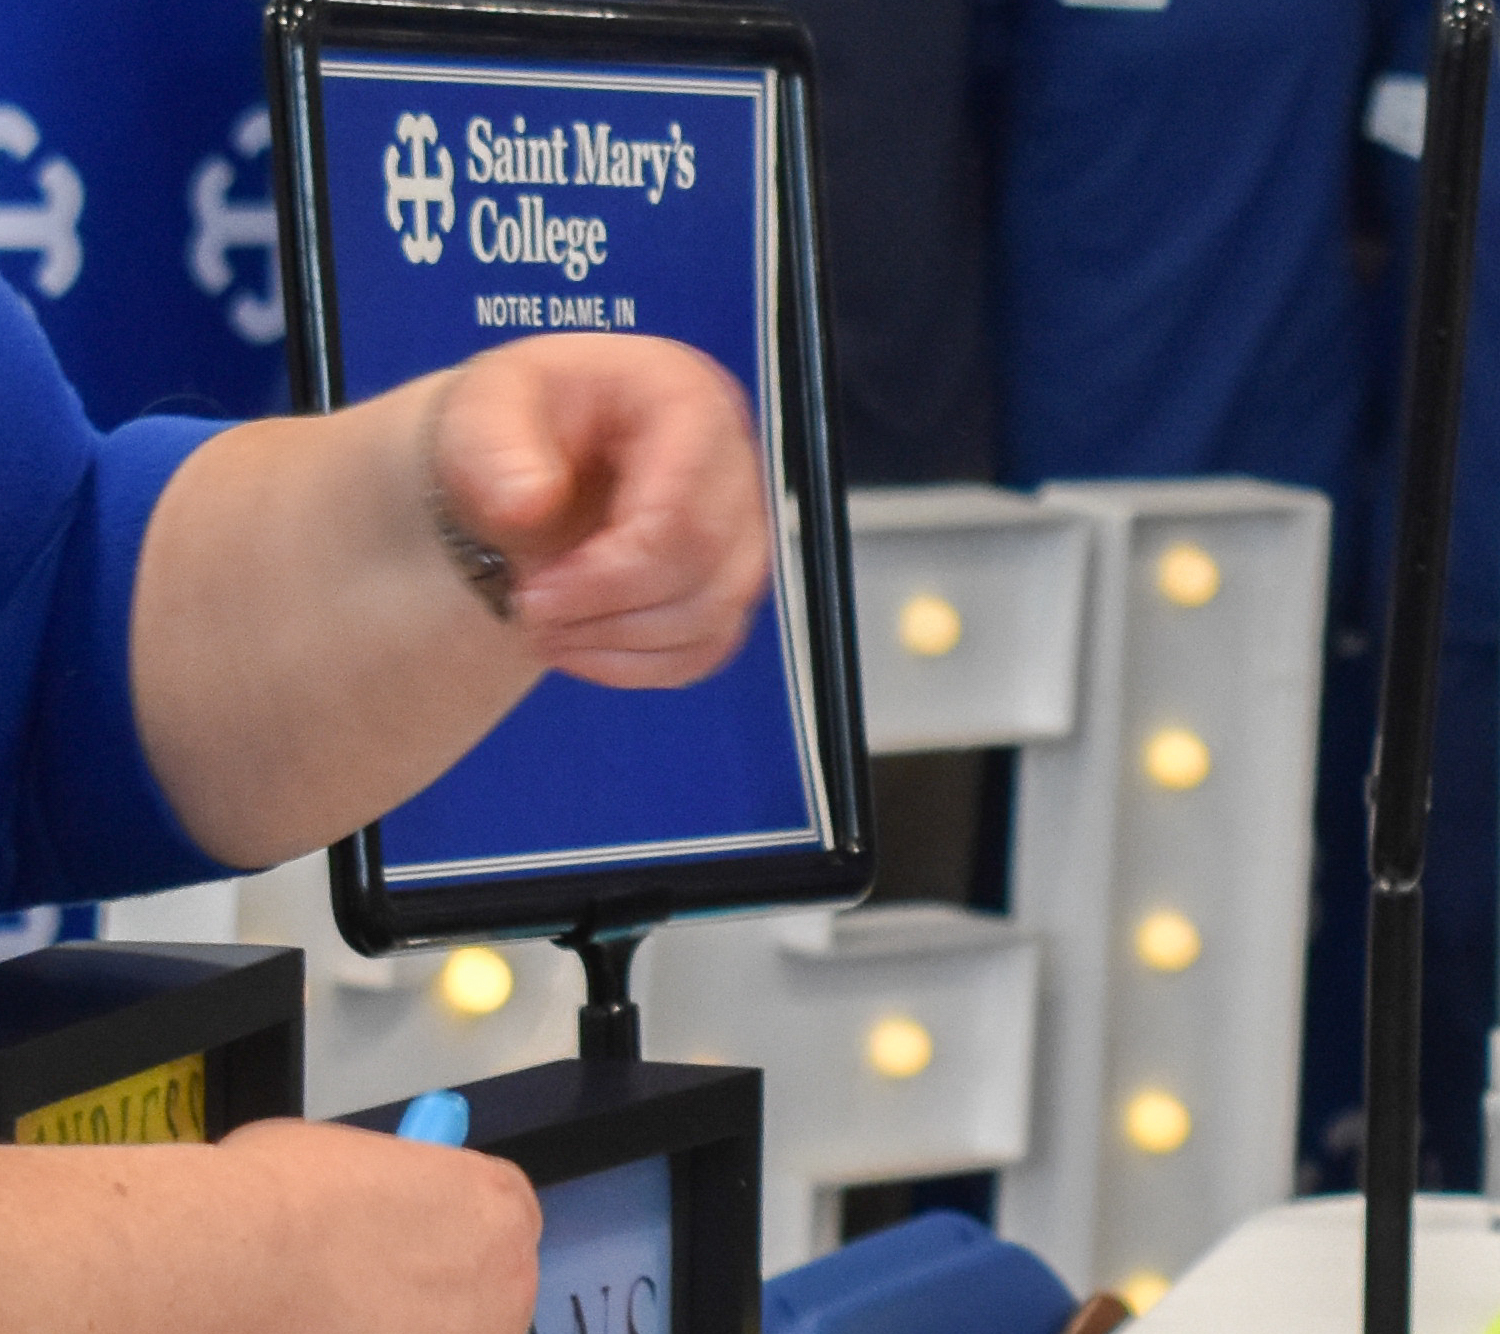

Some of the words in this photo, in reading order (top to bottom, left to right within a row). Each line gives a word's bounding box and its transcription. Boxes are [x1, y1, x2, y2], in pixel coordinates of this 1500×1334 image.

[467, 115, 569, 187] Saint
[469, 195, 608, 282] College
[476, 297, 544, 327] NOTRE
[550, 297, 612, 332] DAME,
[615, 298, 636, 327] IN
